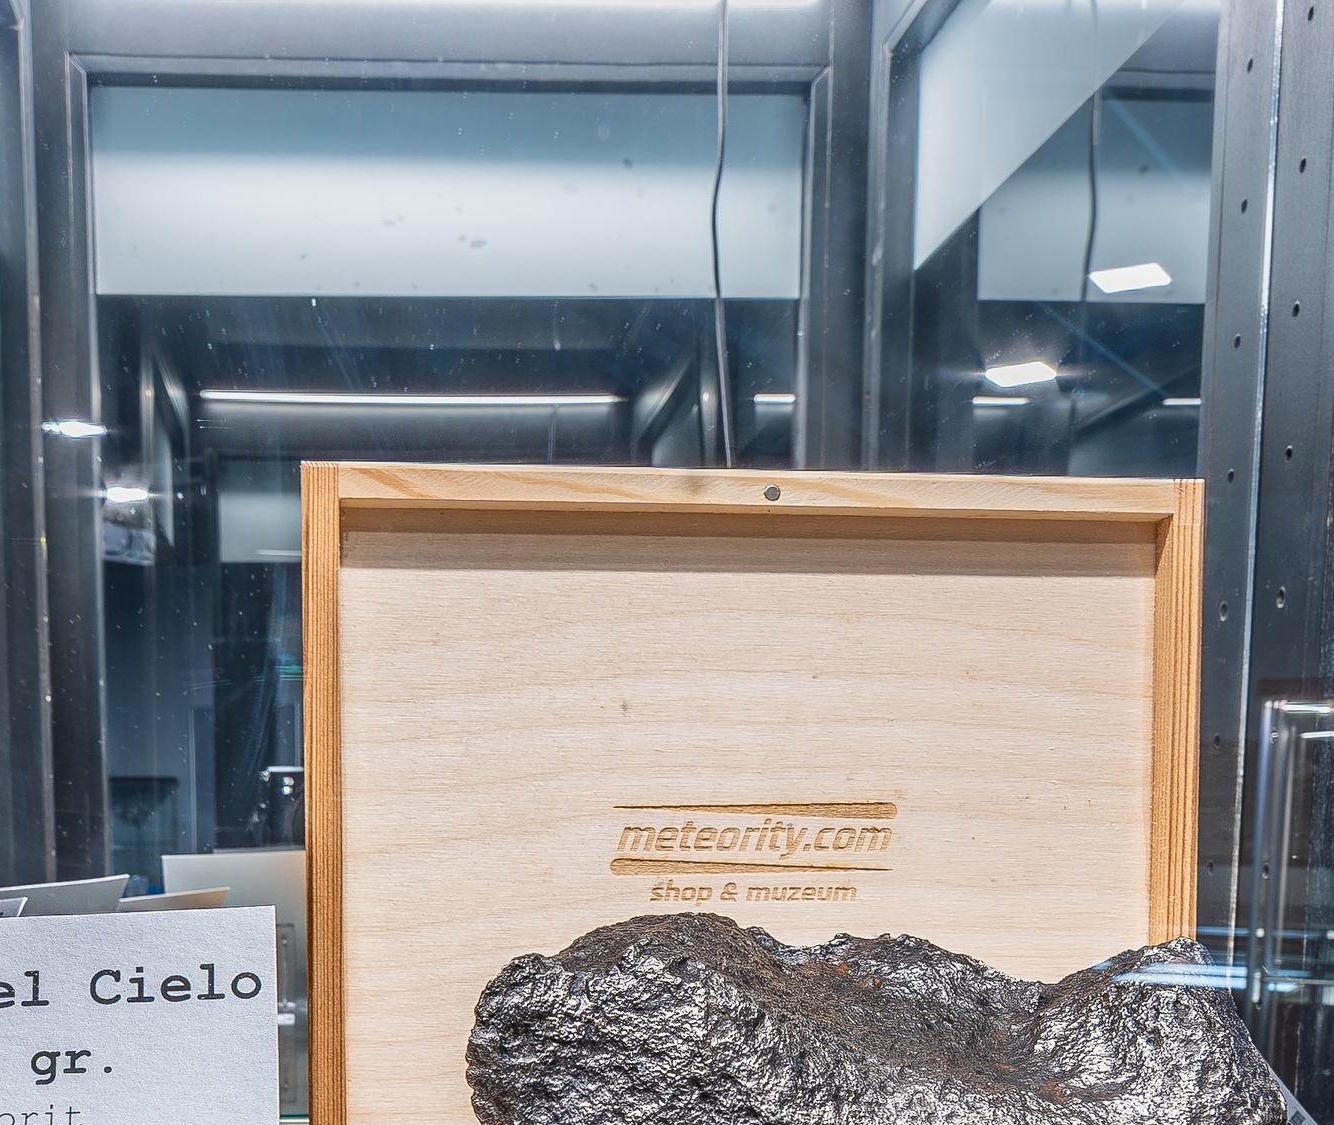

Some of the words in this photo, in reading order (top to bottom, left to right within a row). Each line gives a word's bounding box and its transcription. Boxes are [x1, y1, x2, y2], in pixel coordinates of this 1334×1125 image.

[616, 819, 893, 859] meteority.com
[649, 879, 713, 906] shop
[719, 882, 738, 902] &
[746, 883, 858, 903] muzeum
[90, 962, 263, 1006] Cielo
[30, 1046, 115, 1087] gr.
